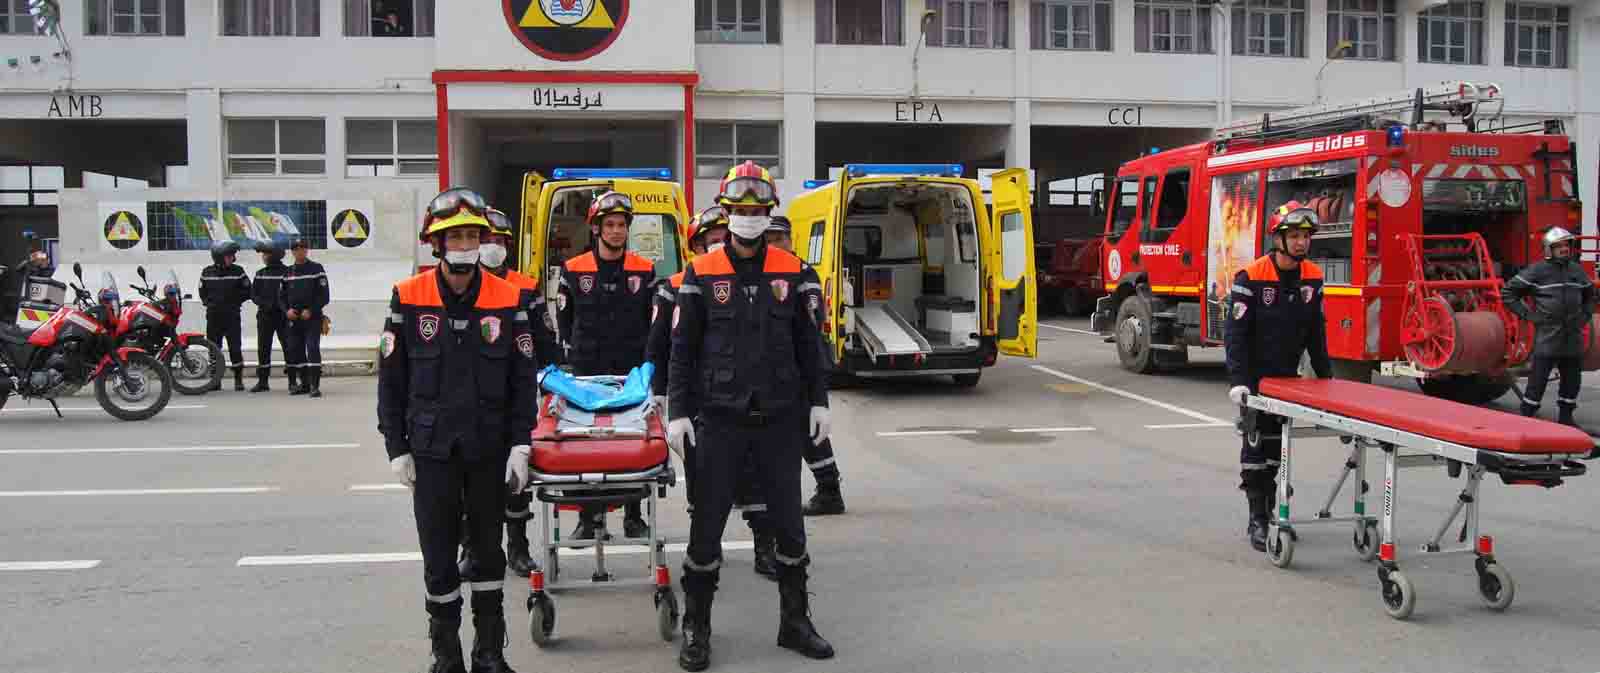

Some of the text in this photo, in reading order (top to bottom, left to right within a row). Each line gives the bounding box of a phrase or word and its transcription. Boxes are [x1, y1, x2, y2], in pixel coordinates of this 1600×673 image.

[47, 95, 103, 117] AMB
[895, 101, 943, 122] EPA
[1108, 106, 1142, 126] CCI
[1313, 134, 1366, 152] sides
[1449, 144, 1499, 157] sides
[635, 192, 670, 204] CIVILE
